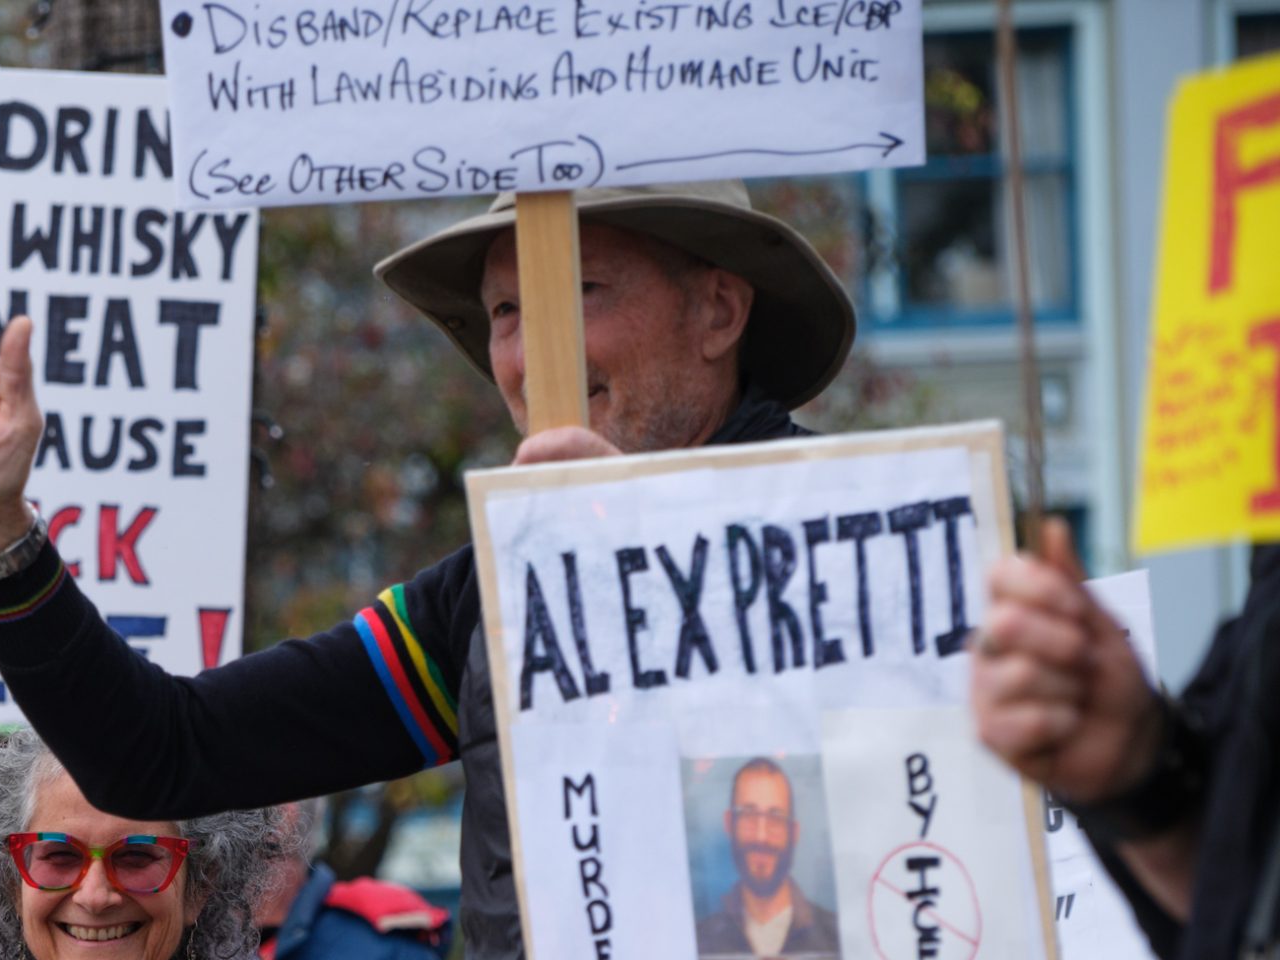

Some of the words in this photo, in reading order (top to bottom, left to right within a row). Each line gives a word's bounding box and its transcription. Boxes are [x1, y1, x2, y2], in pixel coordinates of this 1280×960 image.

[624, 45, 781, 93] HUMANE
[288, 153, 406, 195] OTHER
[9, 202, 250, 281] WHISKY
[35, 411, 208, 478] AUSE
[519, 533, 719, 711] ALEX
[725, 495, 978, 674] PRETTI
